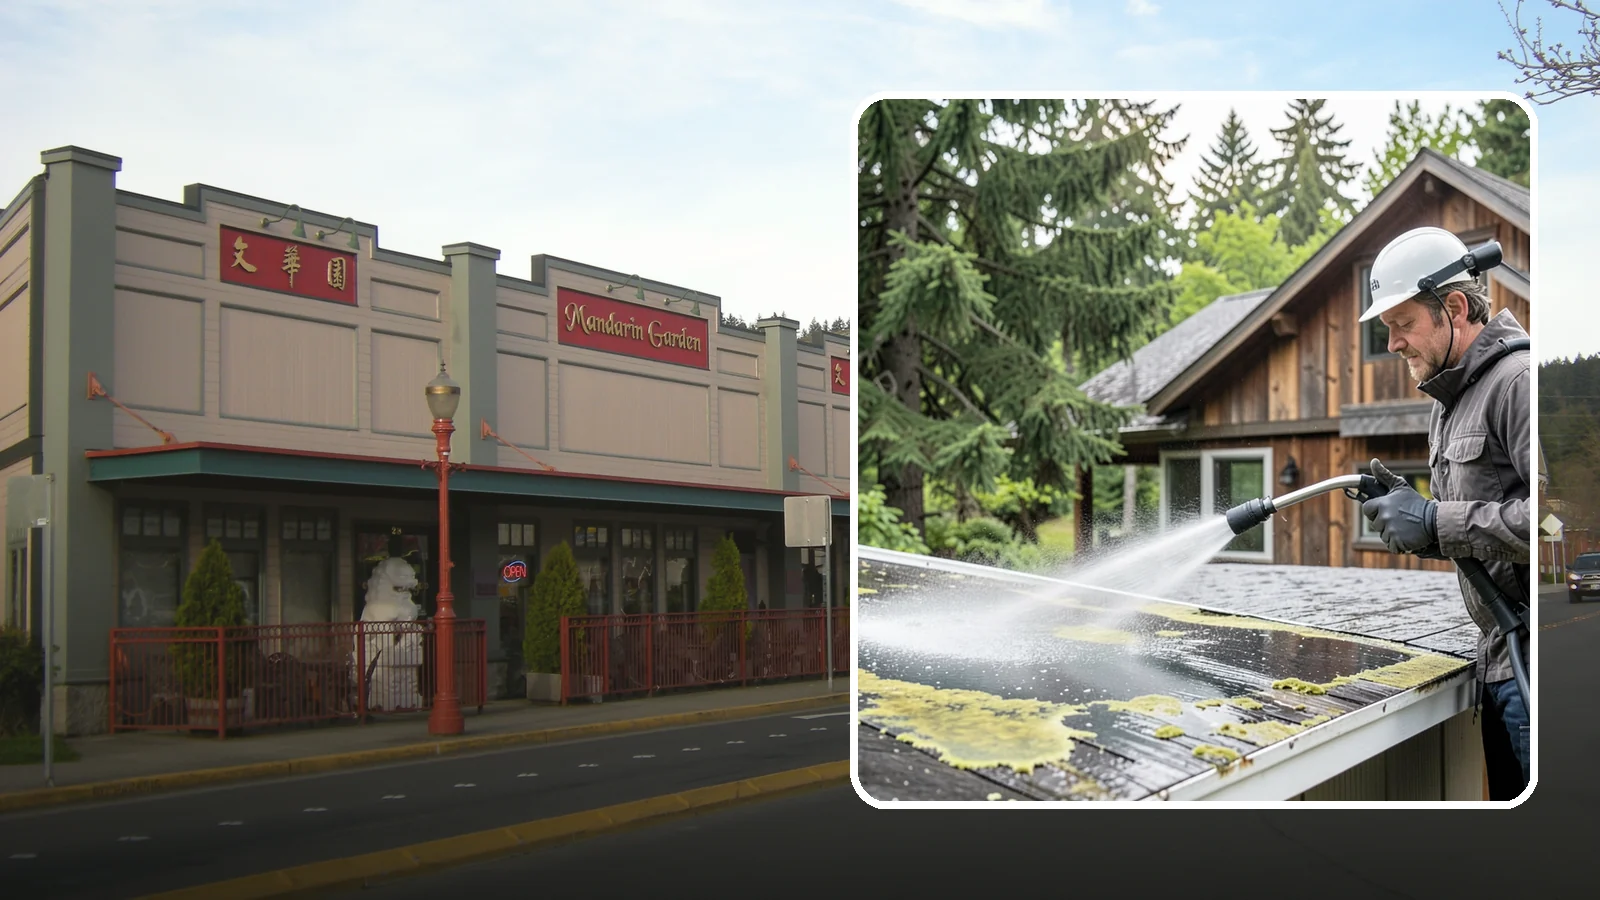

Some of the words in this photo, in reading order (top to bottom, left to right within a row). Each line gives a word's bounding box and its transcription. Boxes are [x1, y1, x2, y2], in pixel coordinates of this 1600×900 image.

[564, 302, 644, 341] Mandarin
[648, 320, 702, 352] Garden
[503, 565, 527, 578] OPEN
